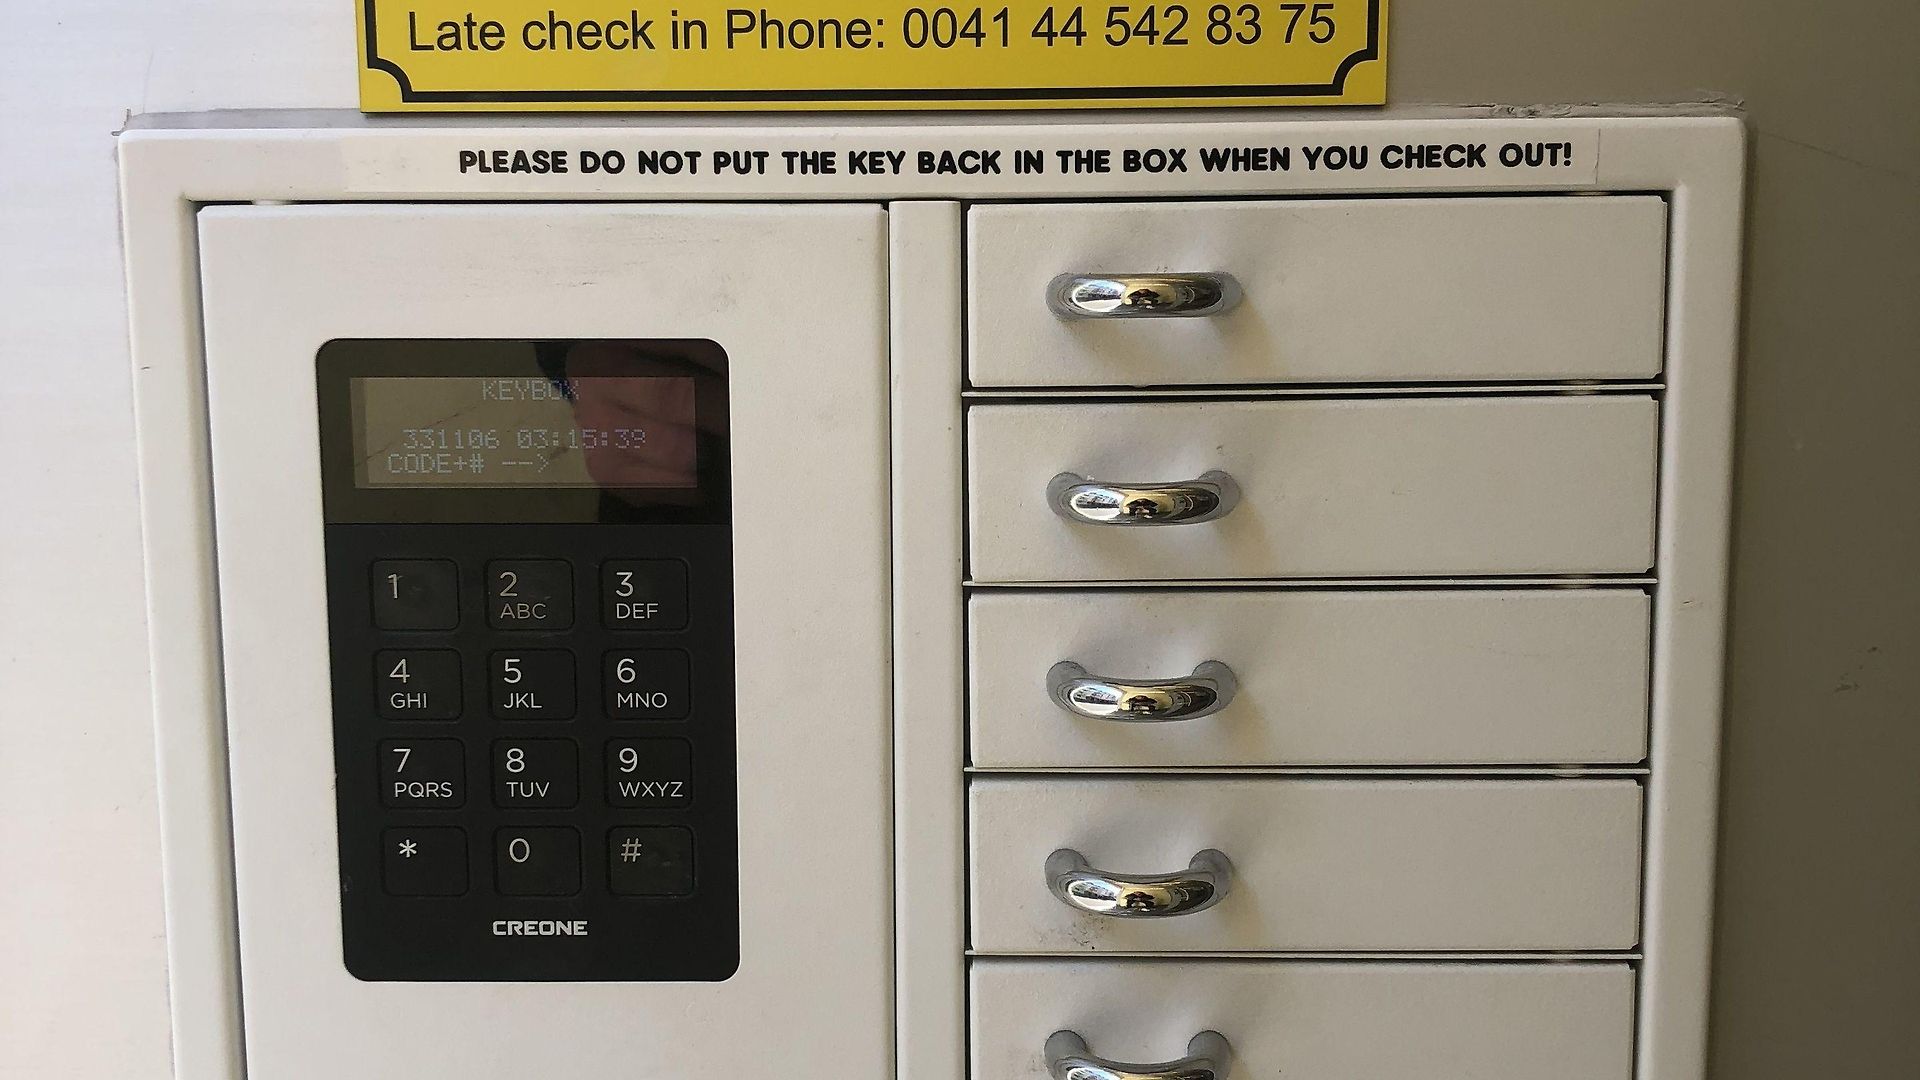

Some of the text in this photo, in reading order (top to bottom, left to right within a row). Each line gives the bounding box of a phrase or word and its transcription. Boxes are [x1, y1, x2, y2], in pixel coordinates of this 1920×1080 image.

[408, 3, 1336, 52] Late check in Phone: 0041 44 542 83 75
[459, 141, 1573, 175] PLEASE DO NOT PUT THE KEY BACK IN THE BOX WHEN YOU CHECK OUT!
[481, 379, 580, 401] KEYBOX
[402, 428, 500, 450] 331106
[387, 453, 485, 474] CODE+#
[387, 573, 400, 599] 1
[499, 571, 518, 597] 2
[615, 571, 634, 597] 3
[500, 603, 547, 619] ABC
[616, 603, 659, 619] DEF
[389, 658, 411, 684] 4
[503, 658, 522, 684] 5
[616, 658, 636, 684] 6
[390, 692, 428, 709] GHI
[503, 692, 543, 709] JKL
[616, 692, 668, 709] MNO
[392, 748, 412, 773] 7
[506, 747, 526, 773] 8
[618, 747, 638, 773] 9
[394, 781, 453, 798] PQRS
[505, 781, 550, 798] TUV
[618, 781, 684, 798] WXYZ
[509, 837, 530, 863] 0
[492, 920, 588, 936] CREONE
